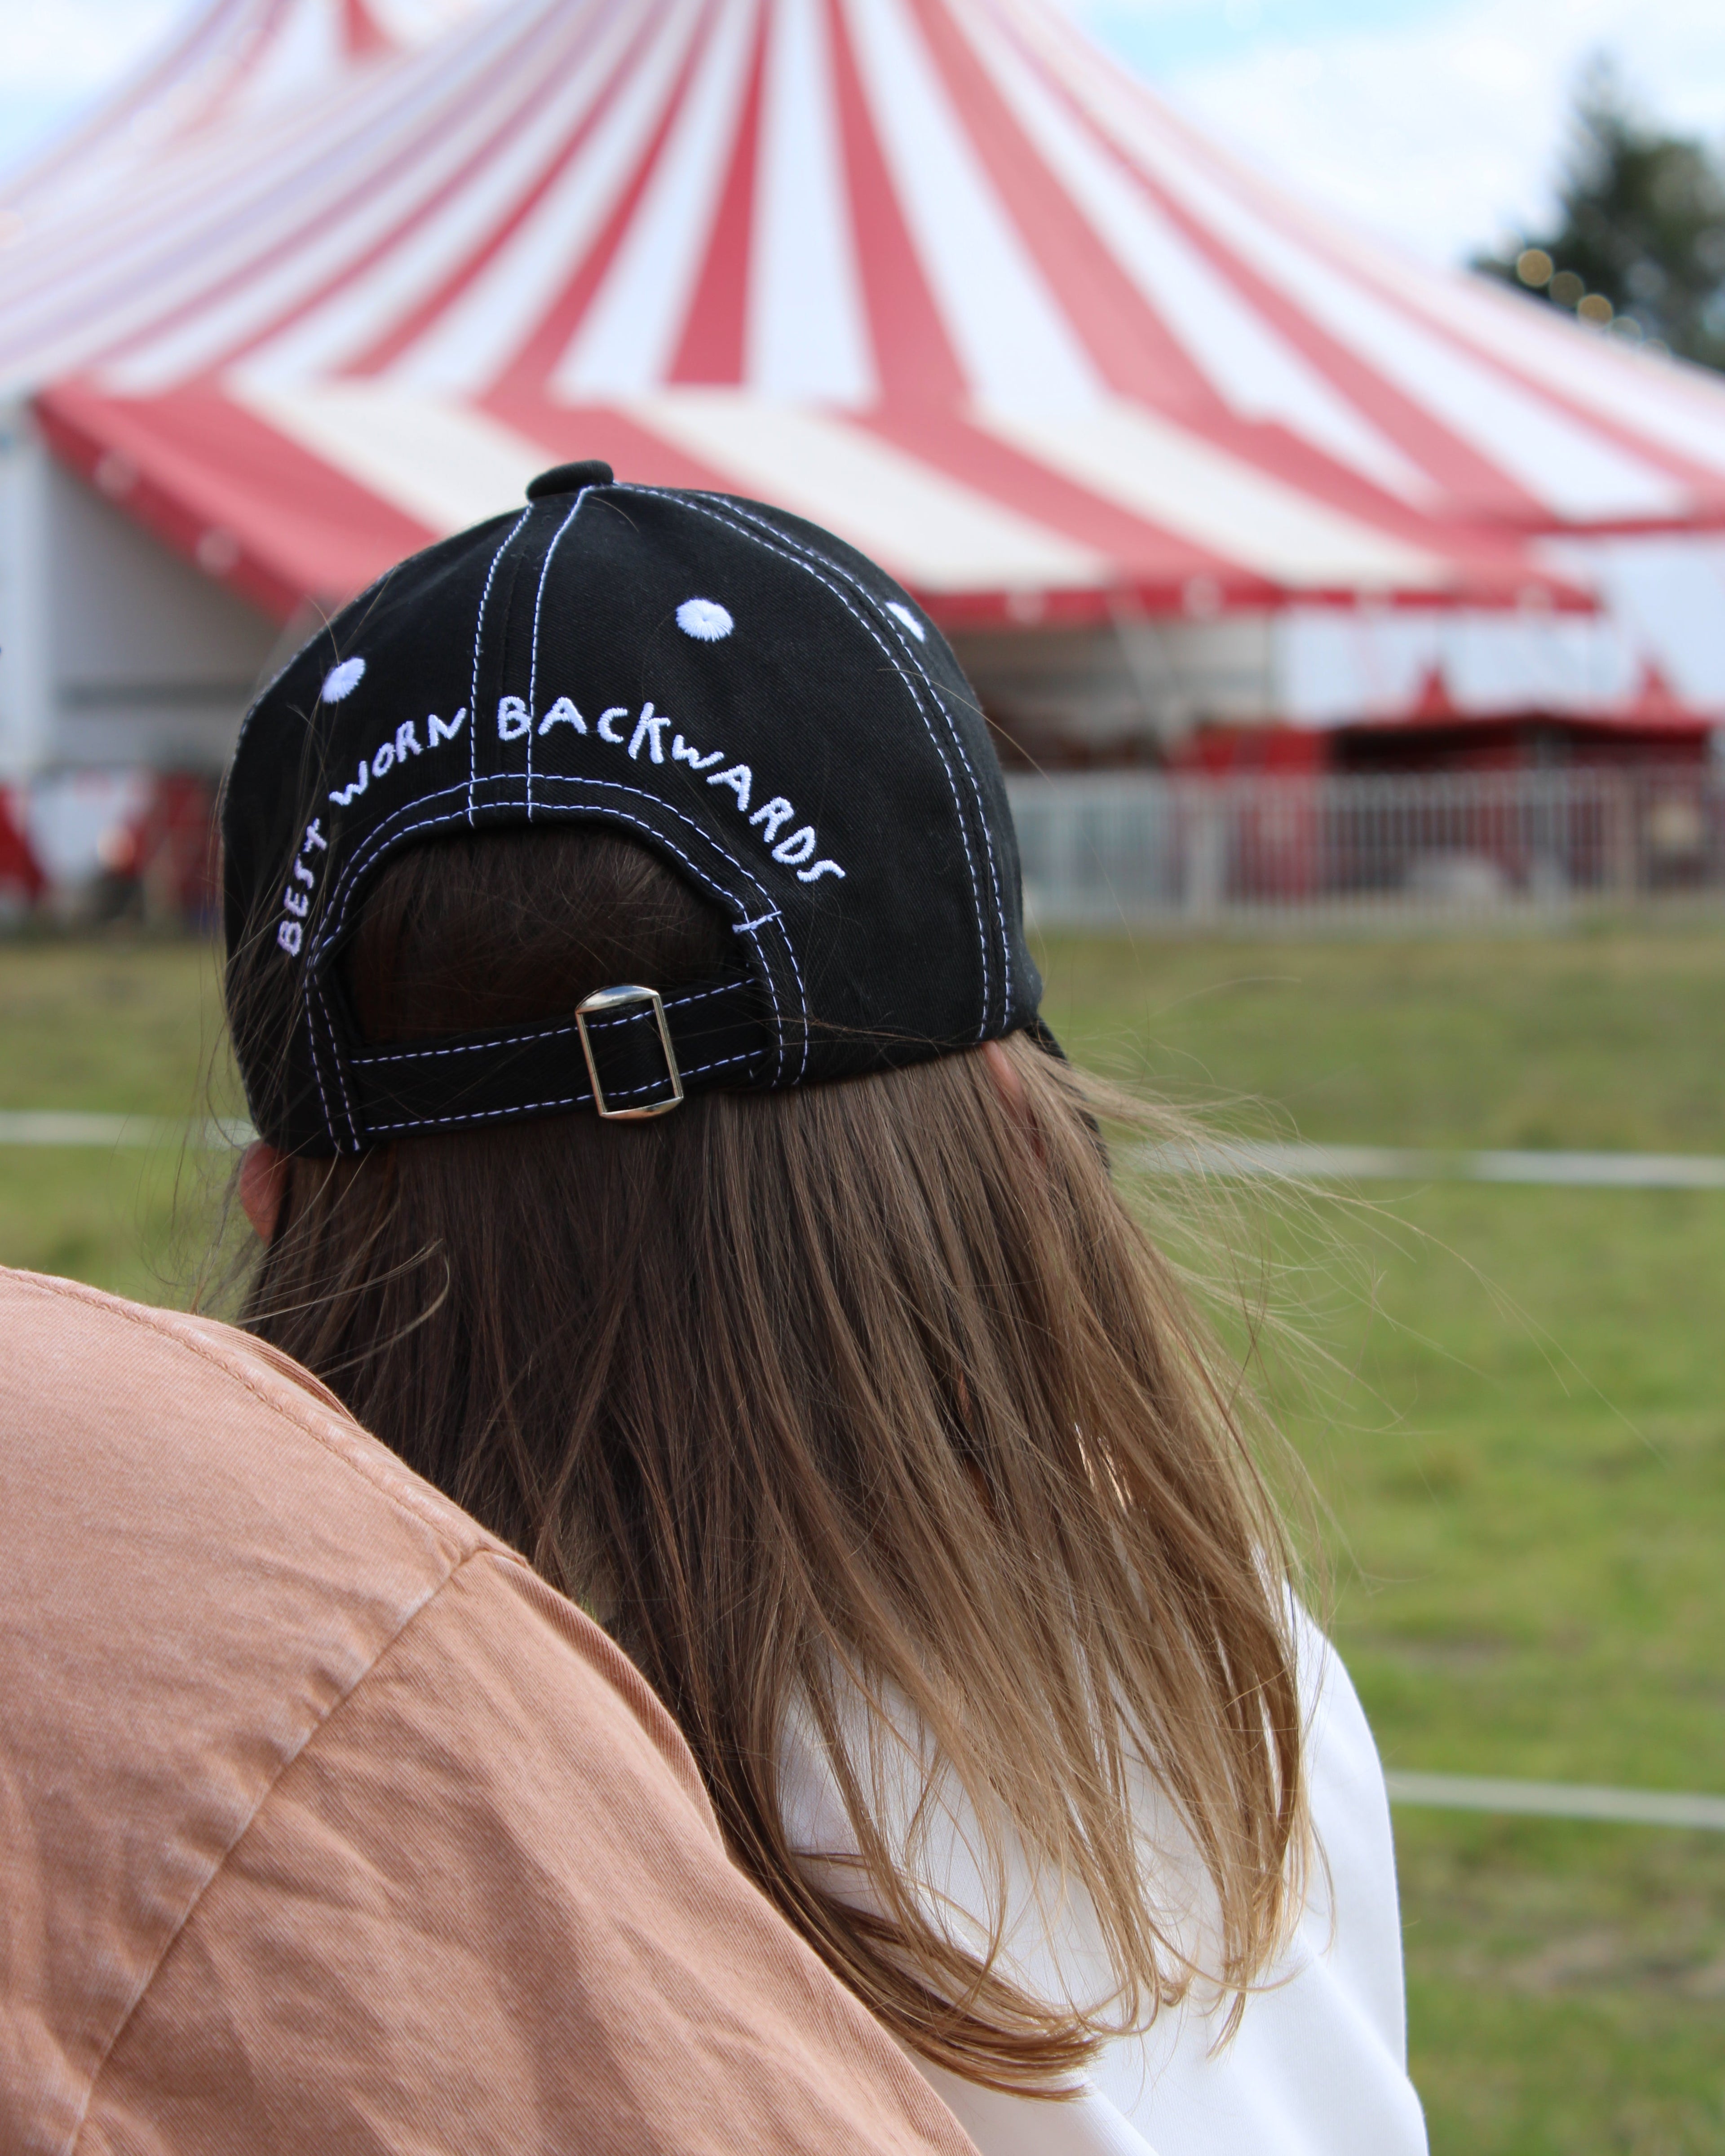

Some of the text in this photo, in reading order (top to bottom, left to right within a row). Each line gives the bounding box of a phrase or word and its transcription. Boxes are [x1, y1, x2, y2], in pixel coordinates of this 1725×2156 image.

[278, 695, 846, 957] BEST WORN BACKWARDS
